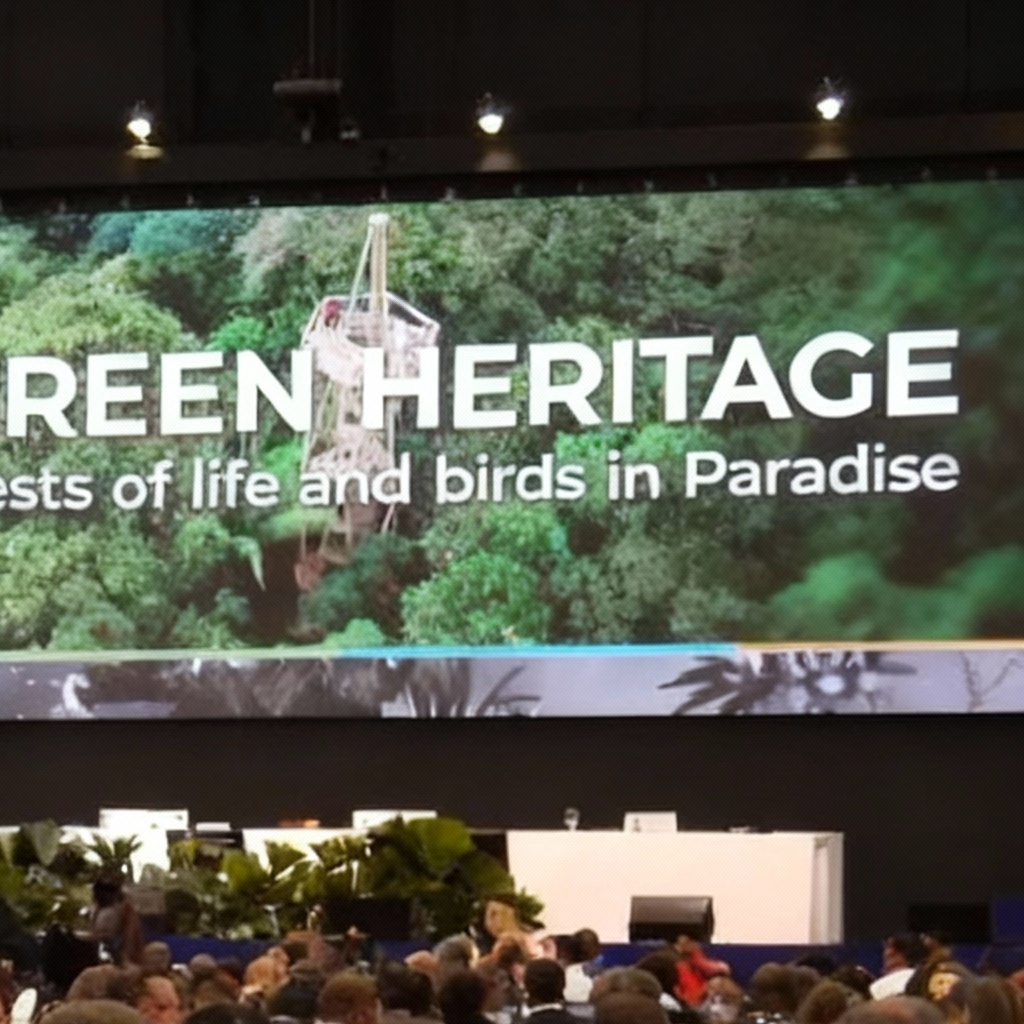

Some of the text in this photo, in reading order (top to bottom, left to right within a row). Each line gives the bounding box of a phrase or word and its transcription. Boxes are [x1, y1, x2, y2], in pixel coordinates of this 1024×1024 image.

[362, 329, 960, 430] HERITAGE
[112, 459, 174, 510] of
[192, 458, 279, 509] life
[299, 452, 410, 507] and
[436, 452, 586, 504] birds
[607, 450, 661, 501] in
[685, 443, 961, 499] Paradise
